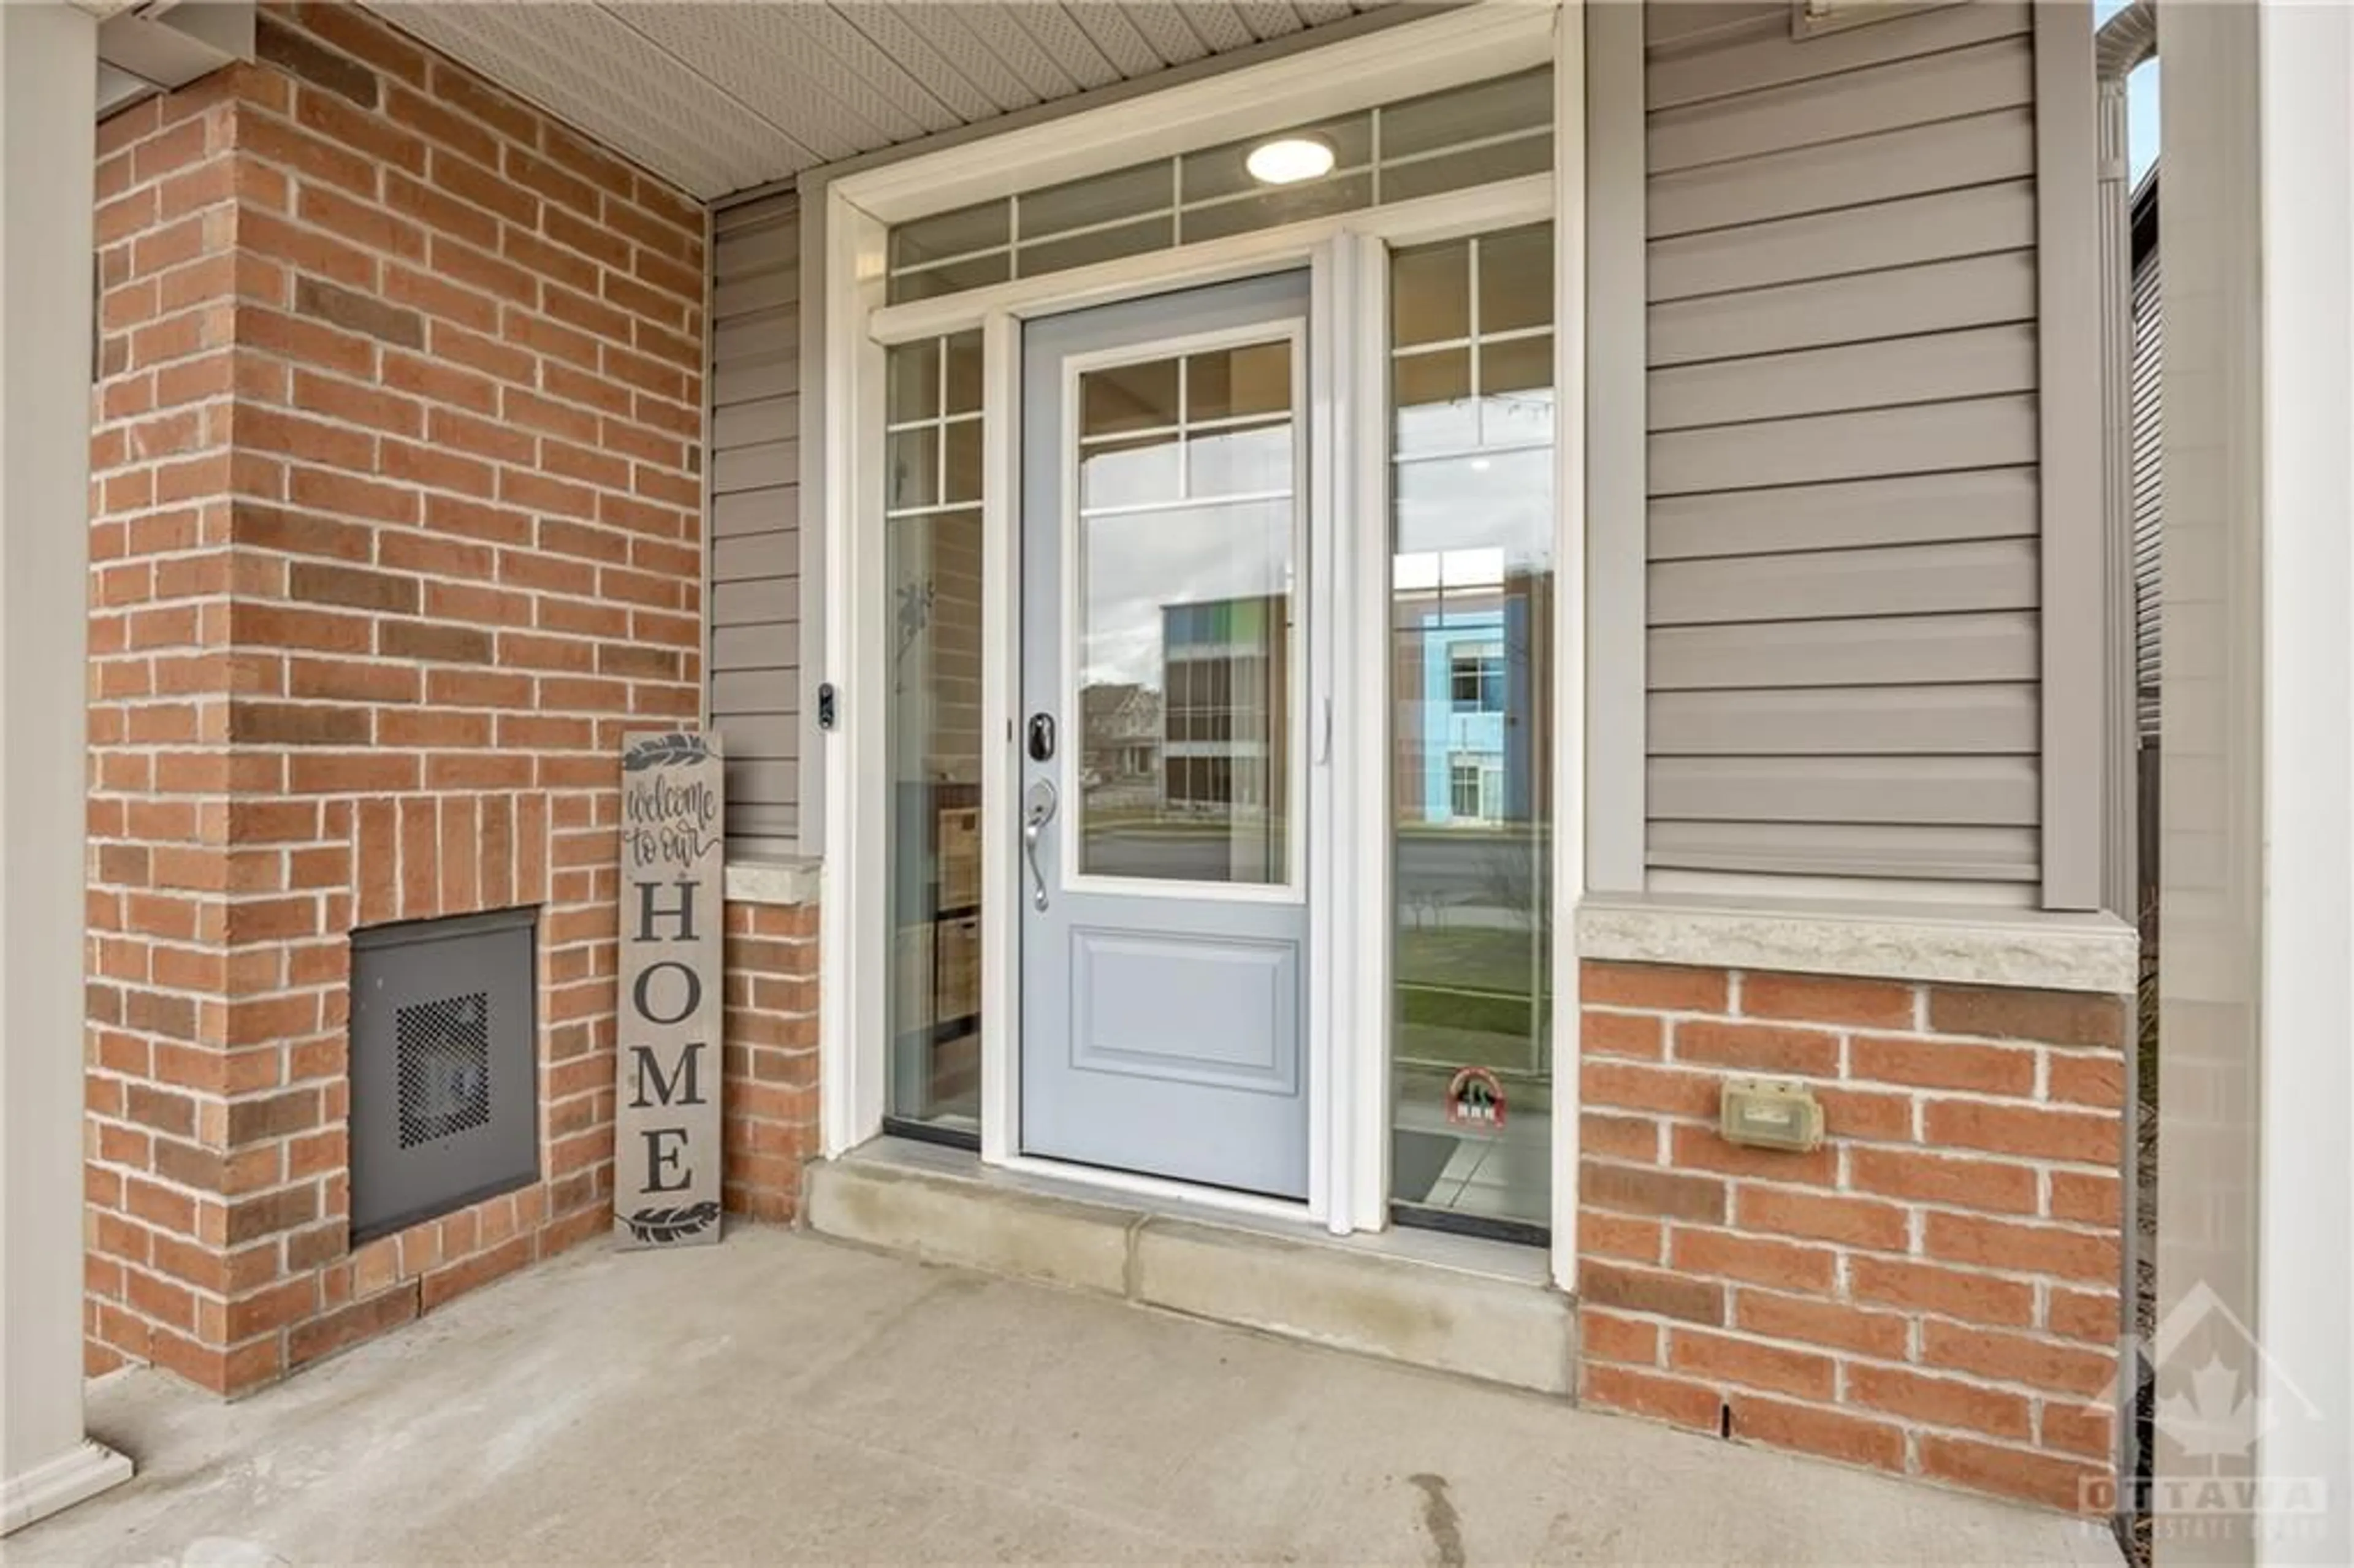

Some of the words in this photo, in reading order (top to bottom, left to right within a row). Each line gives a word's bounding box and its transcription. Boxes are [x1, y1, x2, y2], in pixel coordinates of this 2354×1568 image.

[627, 774, 717, 831] welcome
[625, 827, 657, 868] to
[660, 818, 722, 868] our
[628, 881, 707, 1193] HOME
